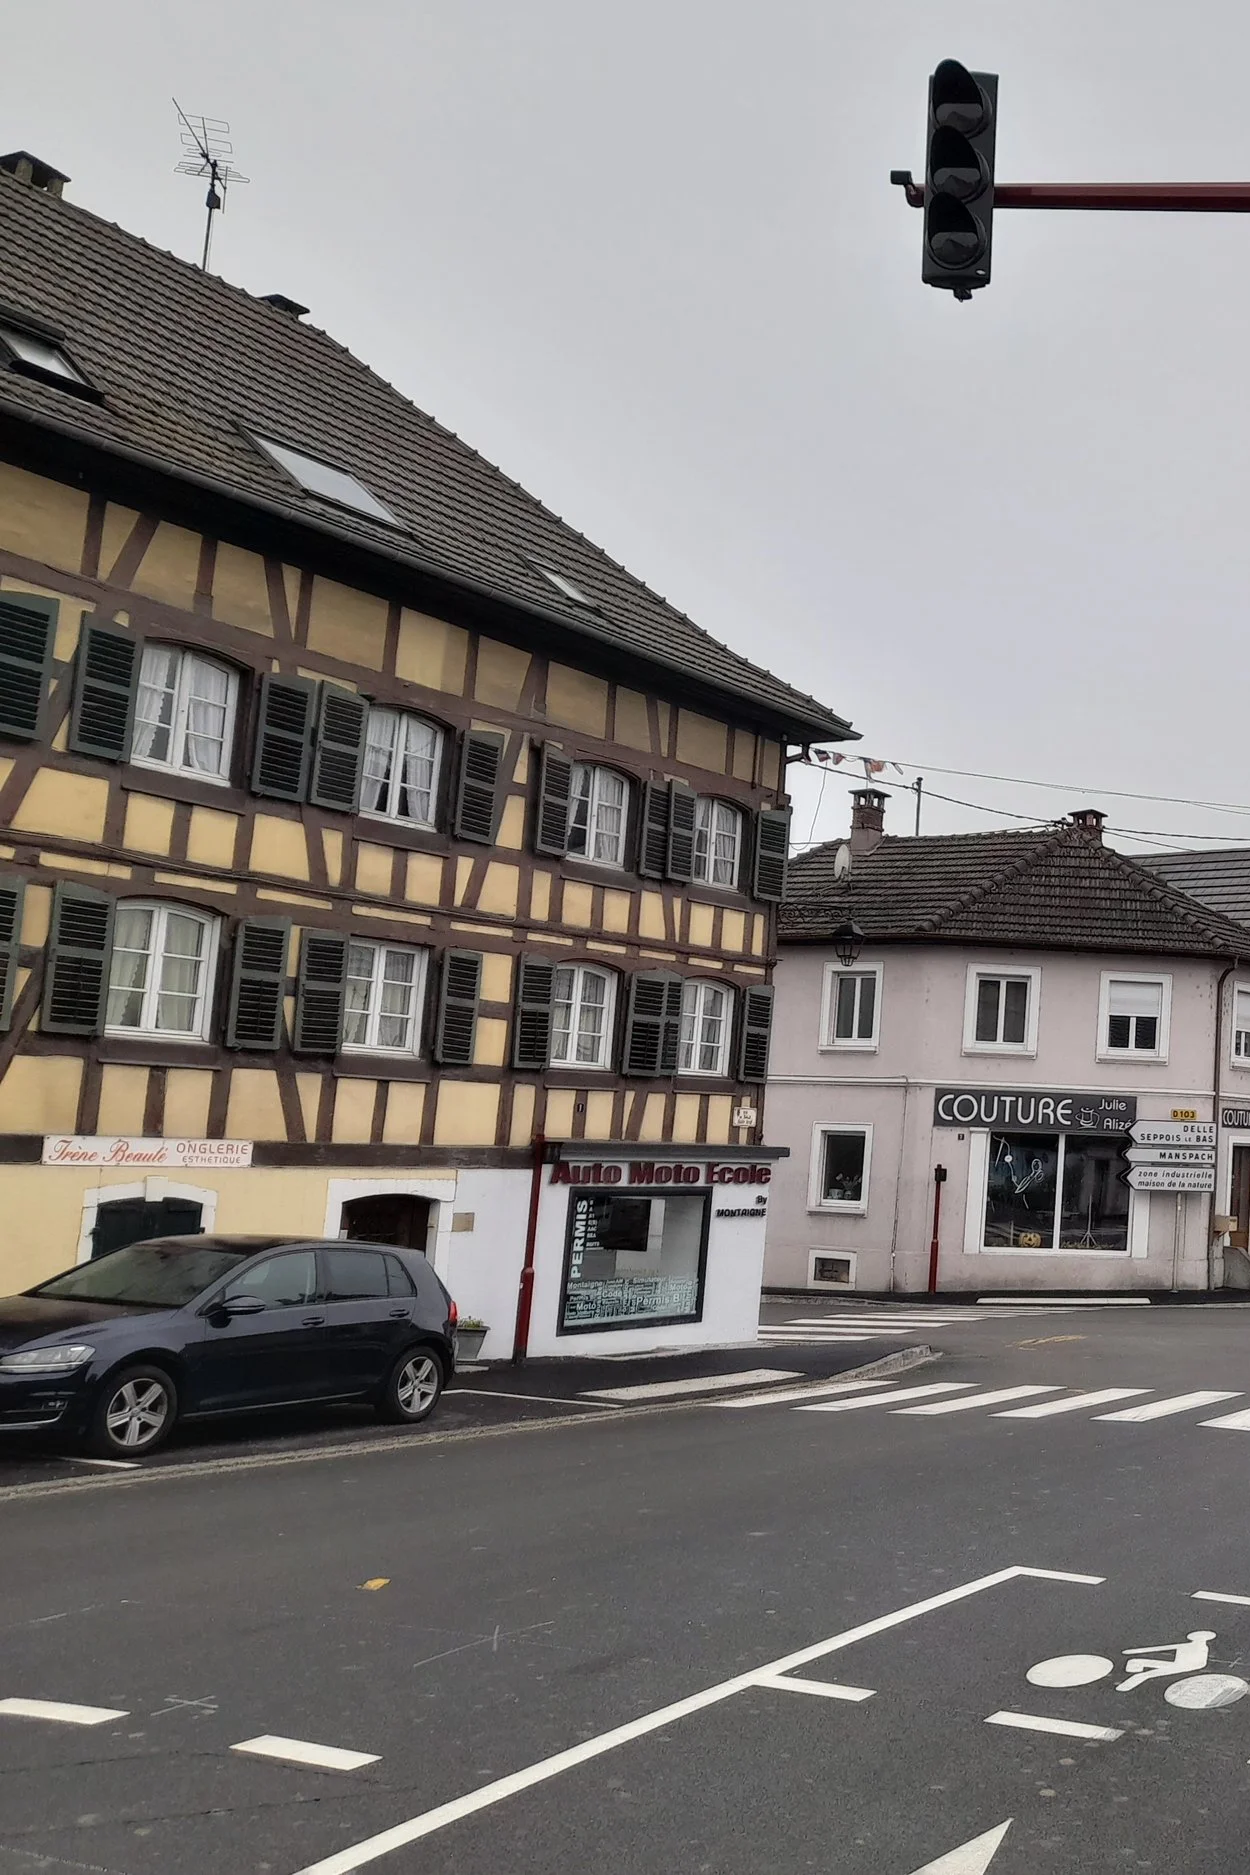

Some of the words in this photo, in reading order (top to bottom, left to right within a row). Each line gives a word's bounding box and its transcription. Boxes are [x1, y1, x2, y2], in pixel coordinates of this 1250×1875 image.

[938, 1094, 1073, 1126] COUTURE
[1098, 1098, 1127, 1112] Julie
[1103, 1117, 1132, 1131] Alizé
[1183, 1125, 1214, 1134] DELLE
[1140, 1133, 1181, 1142] SEPPOIS
[1195, 1135, 1214, 1143] BAS
[49, 1139, 98, 1162] Irène
[176, 1142, 249, 1155] ONGLERIE
[182, 1155, 241, 1164] ESTHETIQUE
[1159, 1151, 1214, 1161] MANSPACH
[551, 1162, 622, 1185] Auto
[628, 1162, 700, 1185] Moto
[705, 1163, 771, 1185] Ecole
[1162, 1170, 1213, 1179] industrielle
[1138, 1180, 1165, 1188] maison
[756, 1195, 768, 1205] By
[716, 1208, 767, 1218] MONTAIGNE
[570, 1199, 588, 1279] PERMIS
[567, 1281, 604, 1290] Montaigne
[602, 1290, 623, 1298] Code
[637, 1296, 670, 1306] Permis
[673, 1293, 680, 1303] B
[577, 1302, 597, 1311] Moto
